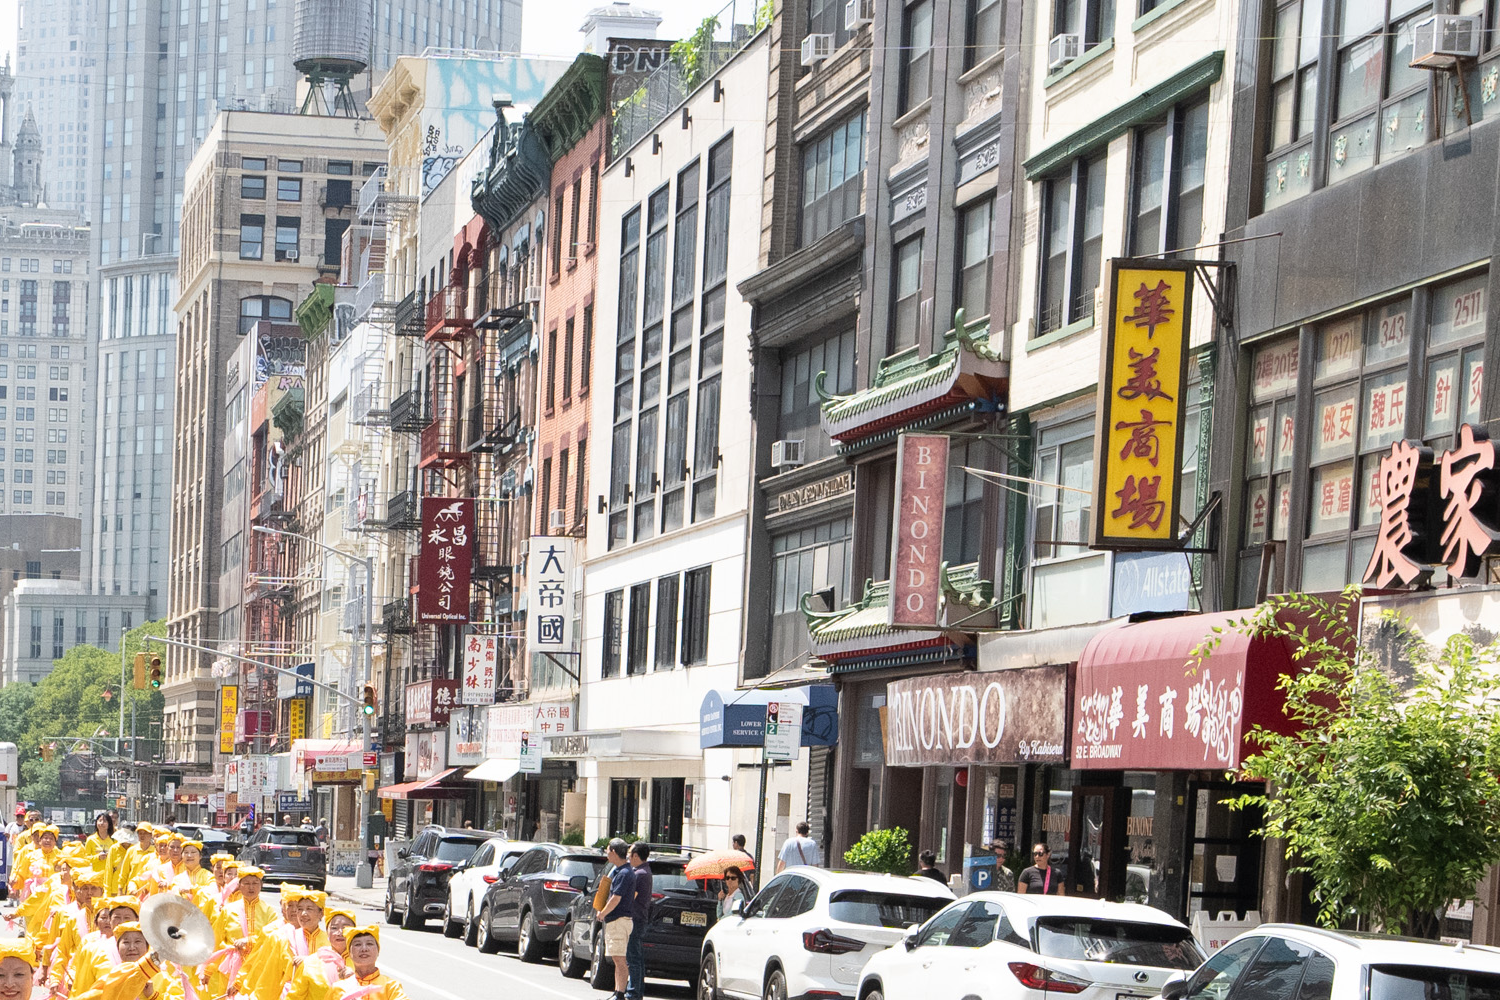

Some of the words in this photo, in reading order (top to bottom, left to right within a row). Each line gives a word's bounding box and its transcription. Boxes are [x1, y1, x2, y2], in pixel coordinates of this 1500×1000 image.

[1381, 315, 1405, 348] 343
[1454, 290, 1481, 328] 2511
[1111, 279, 1176, 531] 華美商場
[427, 524, 468, 546] 永昌
[906, 446, 931, 612] BINONDO
[437, 546, 456, 610] 眼鏡公司
[538, 544, 565, 644] 大帝國
[1141, 566, 1189, 598] Allstate
[422, 612, 441, 620] Universal
[536, 706, 570, 719] 大帝國
[894, 682, 1006, 752] BINONDO
[1107, 682, 1202, 741] 華美商場
[1076, 747, 1083, 759] 52
[1090, 744, 1122, 758] BROADWAY
